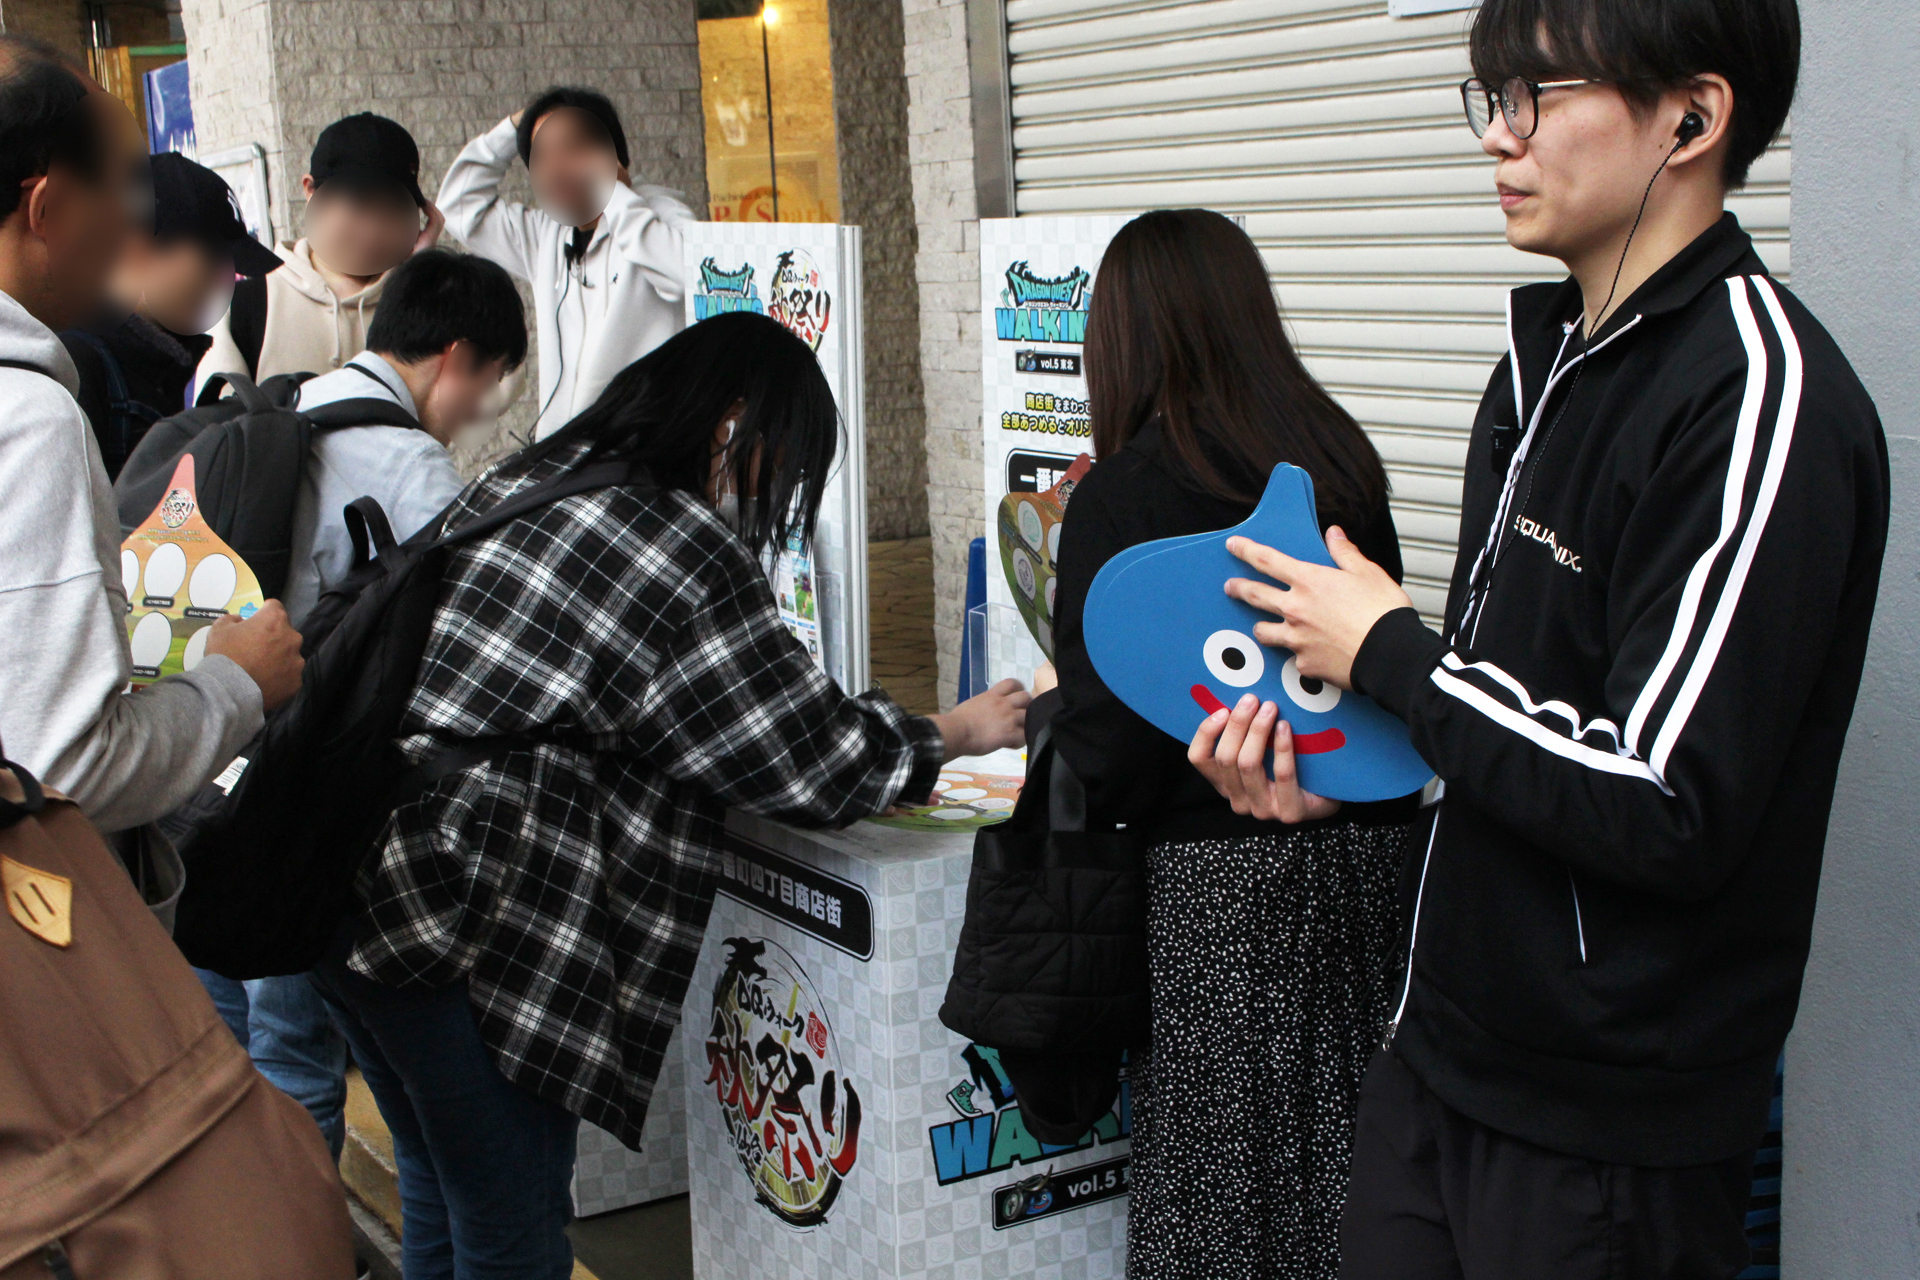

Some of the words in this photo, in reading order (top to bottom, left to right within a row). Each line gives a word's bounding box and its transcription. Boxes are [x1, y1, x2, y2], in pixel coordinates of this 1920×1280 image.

[1007, 271, 1051, 304] DRAGON
[1051, 271, 1089, 305] QUEST
[995, 308, 1090, 344] WALKIN
[1041, 358, 1059, 369] vol.5
[704, 1008, 862, 1183] 秋祭り
[1068, 1170, 1116, 1198] vol.5
